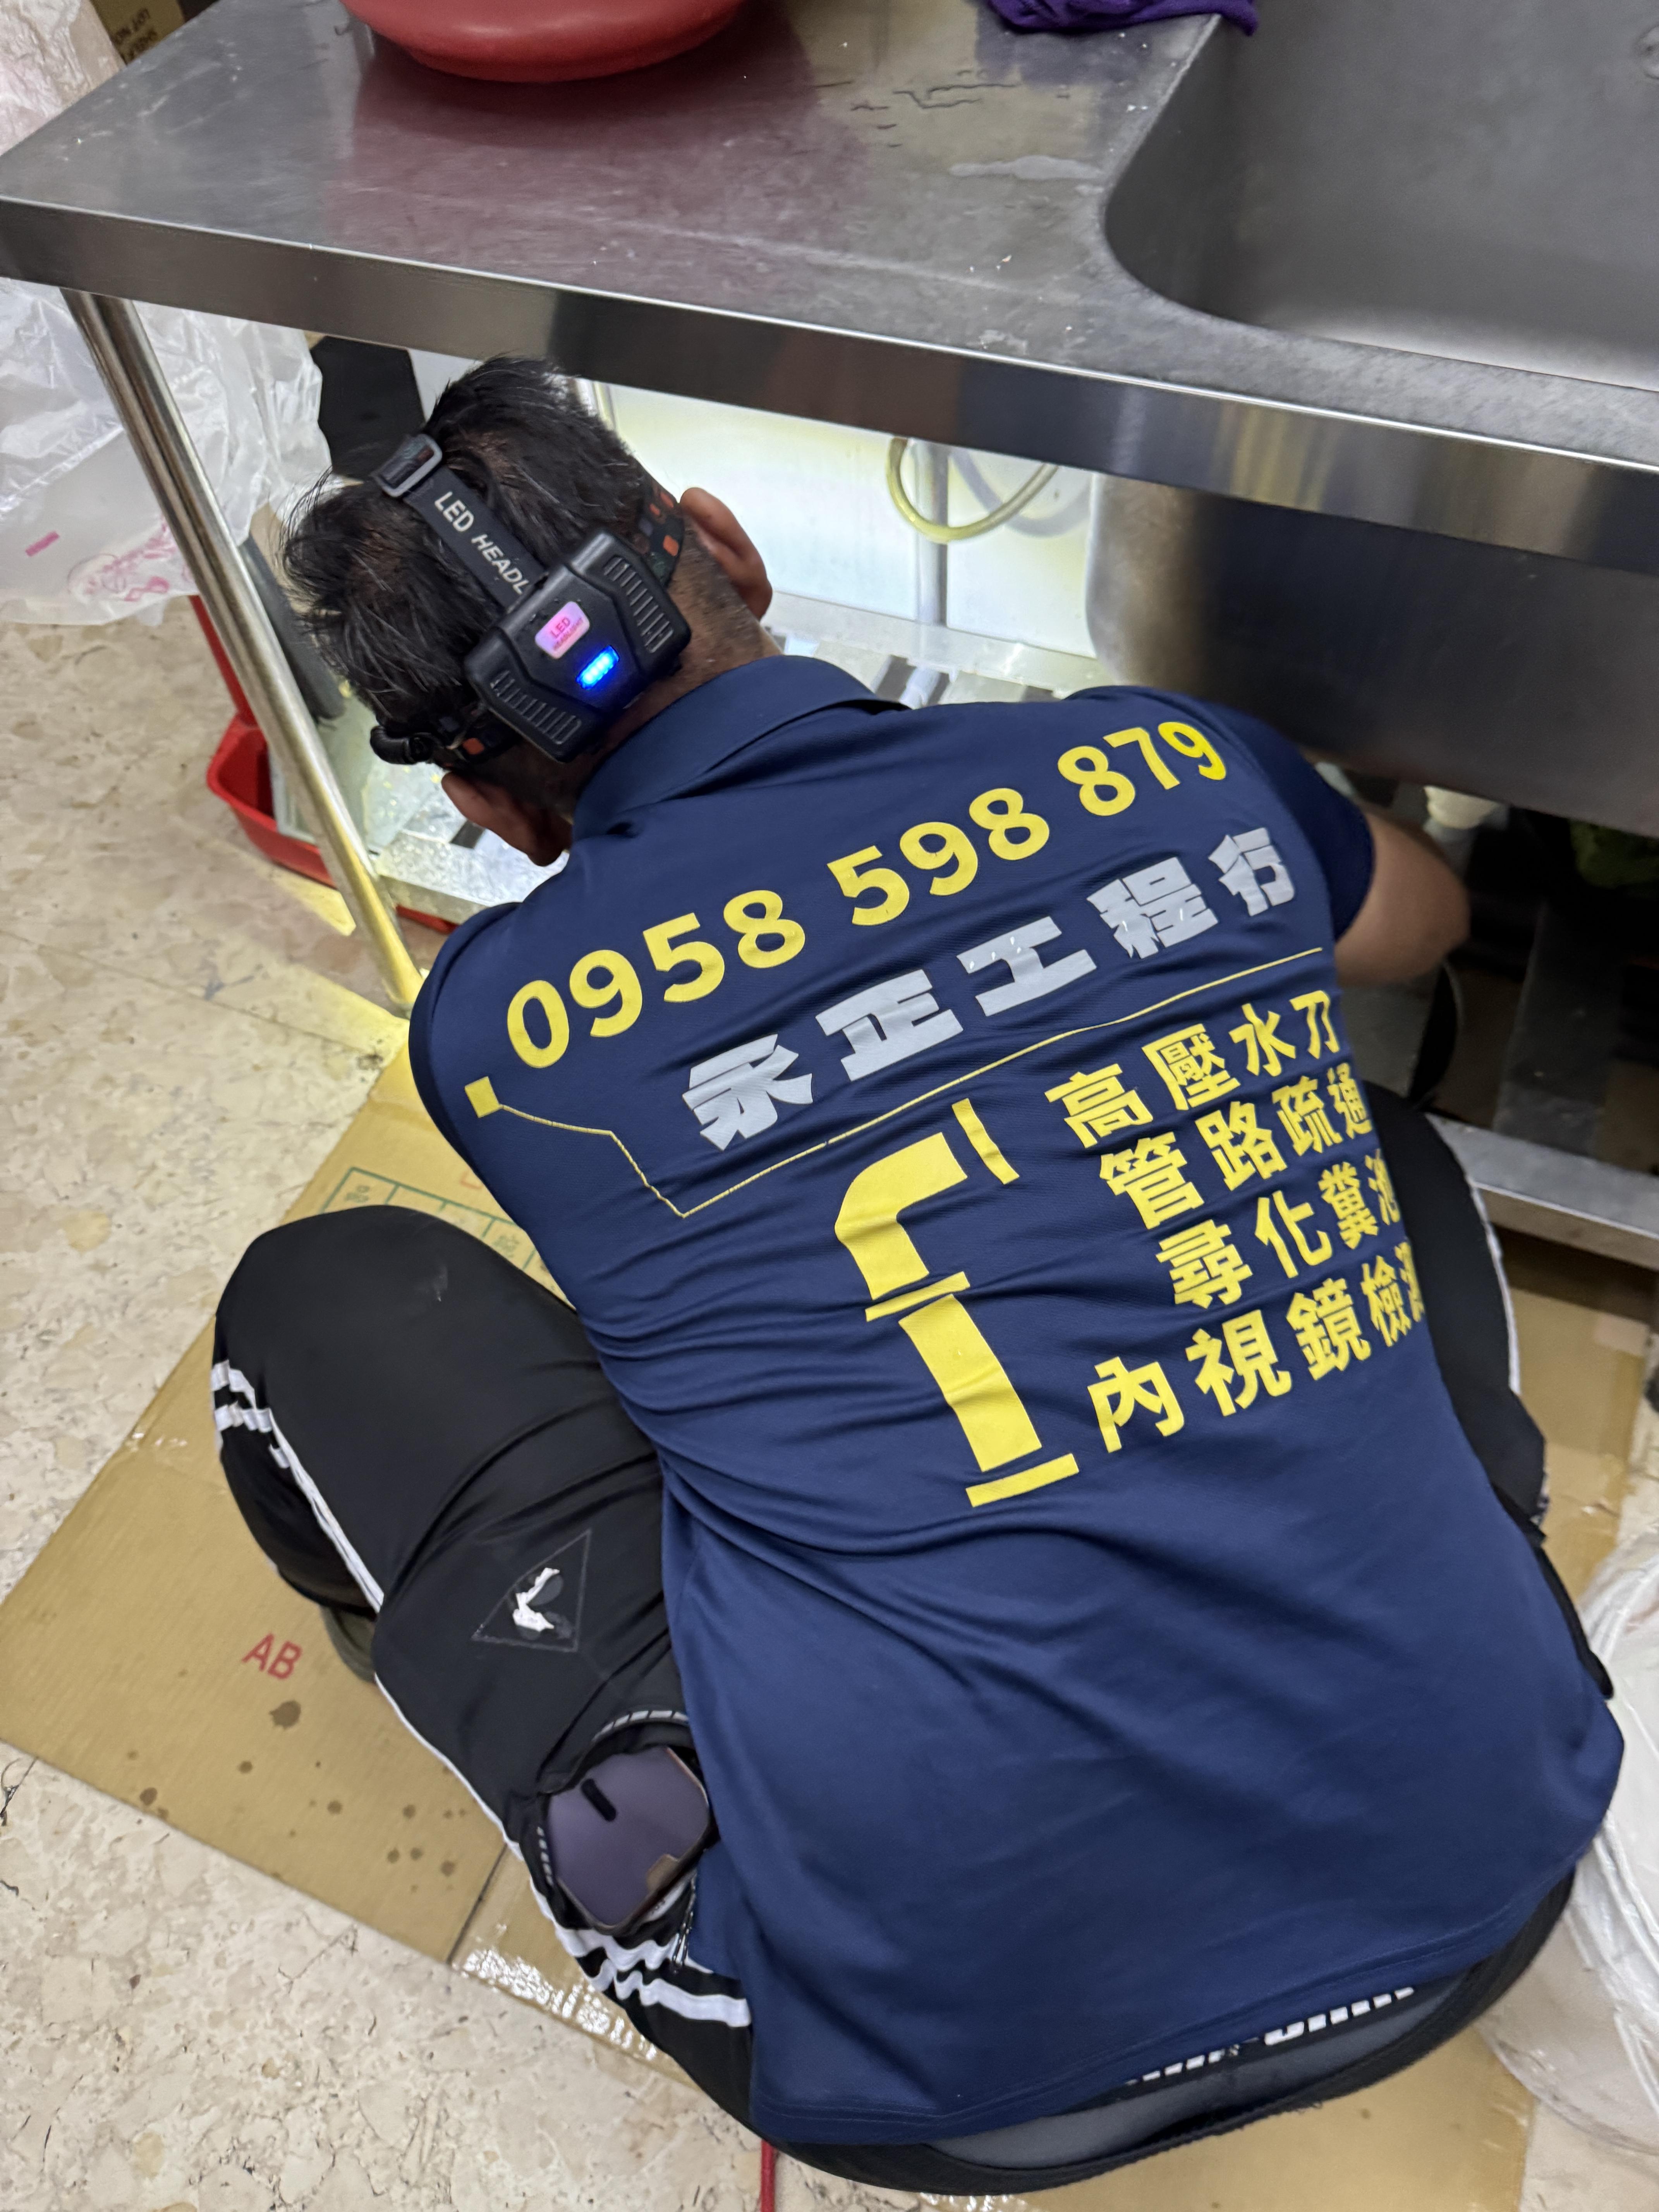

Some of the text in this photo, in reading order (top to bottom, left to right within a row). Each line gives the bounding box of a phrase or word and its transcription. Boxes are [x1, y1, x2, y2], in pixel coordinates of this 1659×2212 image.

[434, 491, 474, 532] LED
[550, 617, 571, 639] LED
[507, 721, 1227, 1068] 0958 598 879
[682, 827, 1296, 1151] 永正工程行
[1044, 990, 1340, 1149] 高壓水刀
[1099, 1063, 1373, 1230] 管路疏通
[242, 1633, 302, 1679] AB
